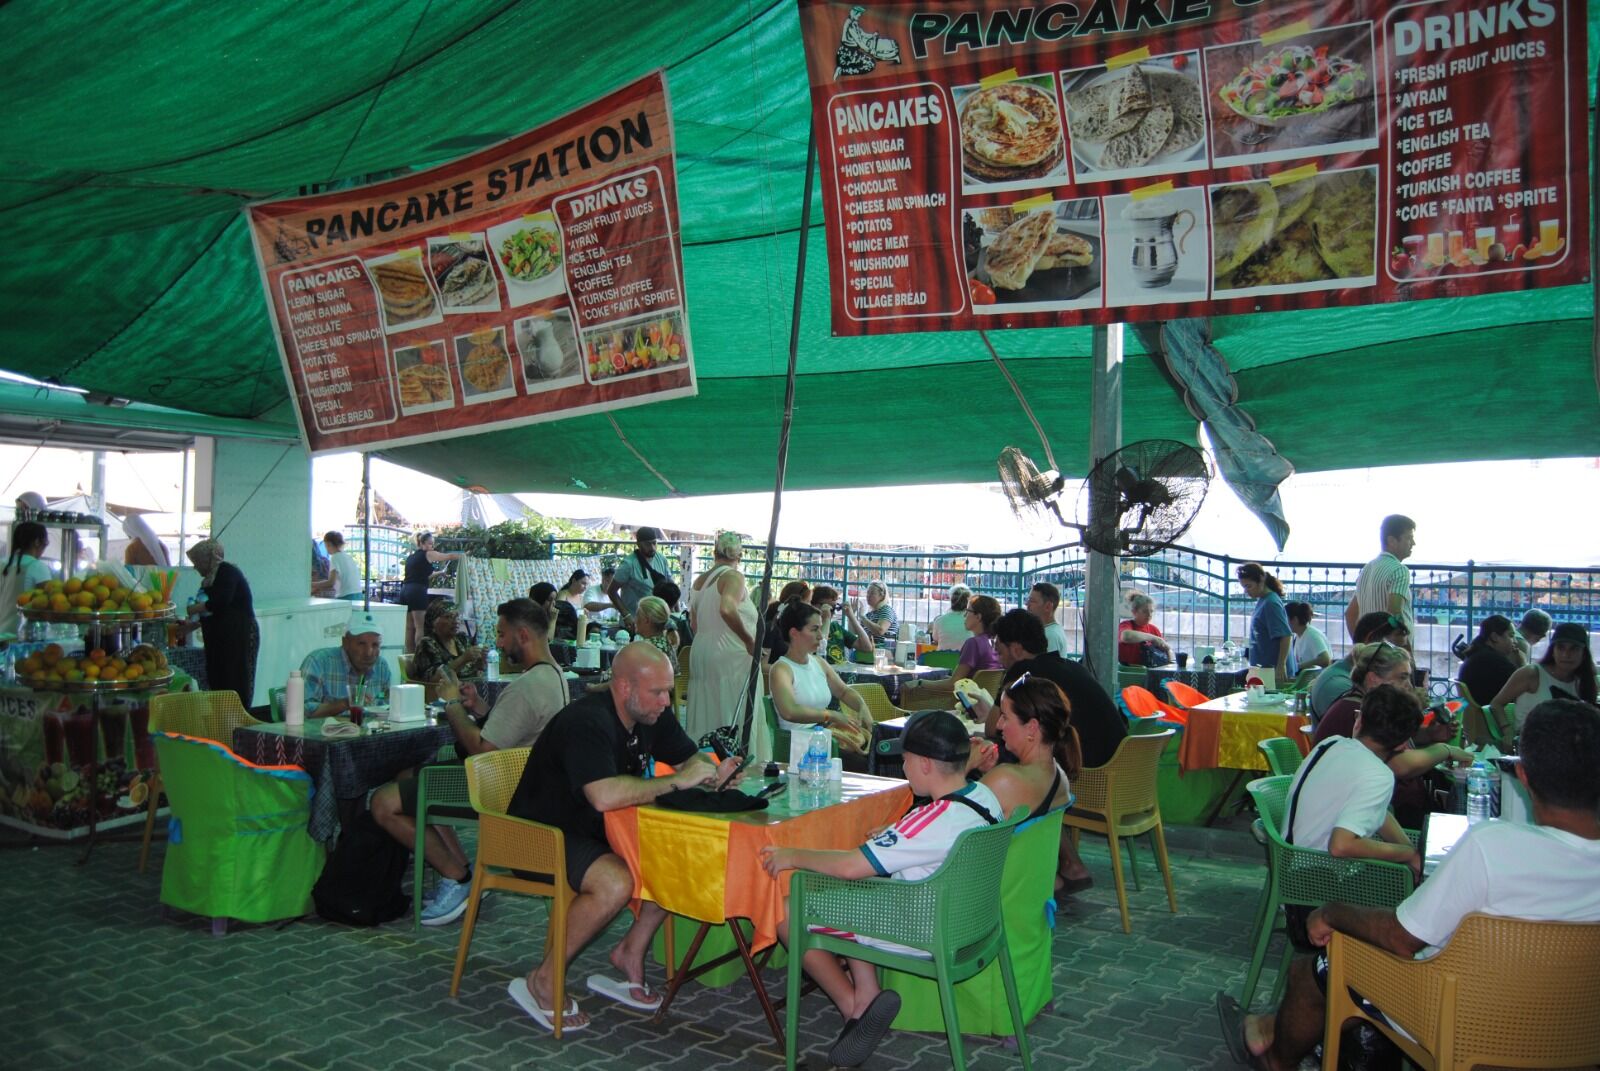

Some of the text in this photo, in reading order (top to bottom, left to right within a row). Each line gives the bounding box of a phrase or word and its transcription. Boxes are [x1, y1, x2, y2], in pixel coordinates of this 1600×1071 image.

[1394, 0, 1556, 57] DRINKS
[1401, 41, 1546, 85] FRESH FRUIT JUICES
[1401, 87, 1447, 109] AYRAN
[835, 95, 943, 136] PANCAKES
[1402, 108, 1453, 132] ICE TEA
[843, 139, 905, 158] LEMON SUGAR
[1402, 123, 1491, 155] ENGLISH TEA
[845, 158, 912, 177] HONEY BANANA
[1402, 153, 1452, 177] COFFEE
[305, 111, 654, 250] PANCAKE STATION
[847, 179, 899, 197] CHOCOLATE
[1401, 169, 1521, 199] TURKISH COFFEE
[569, 178, 648, 219] DRINKS
[849, 194, 947, 216] CHEESE AND SPINACH
[1400, 187, 1558, 222] COKE FANTA SPRITE
[570, 202, 654, 236] FRESH FRUIT JUICES
[850, 218, 893, 235] POTATOS
[570, 234, 599, 251] AYRAN
[587, 247, 606, 259] TEA
[852, 236, 909, 253] MINCE MEAT
[574, 255, 633, 279] ENGLISH TEA
[853, 255, 909, 272] MUSHROOM
[288, 266, 361, 293] PANCAKES
[577, 275, 614, 292] COFFEE
[854, 276, 894, 291] SPECIAL
[317, 289, 346, 303] SUGAR
[581, 279, 653, 306] TURKISH COFFEE
[853, 292, 928, 309] VILLAGE BREAD
[318, 303, 353, 318] BANANA
[584, 289, 676, 320] COKE FANTA SPRITE
[329, 336, 345, 347] AND
[346, 329, 382, 344] SPINACH
[330, 367, 351, 379] MEAT
[347, 410, 374, 423] BREAD
